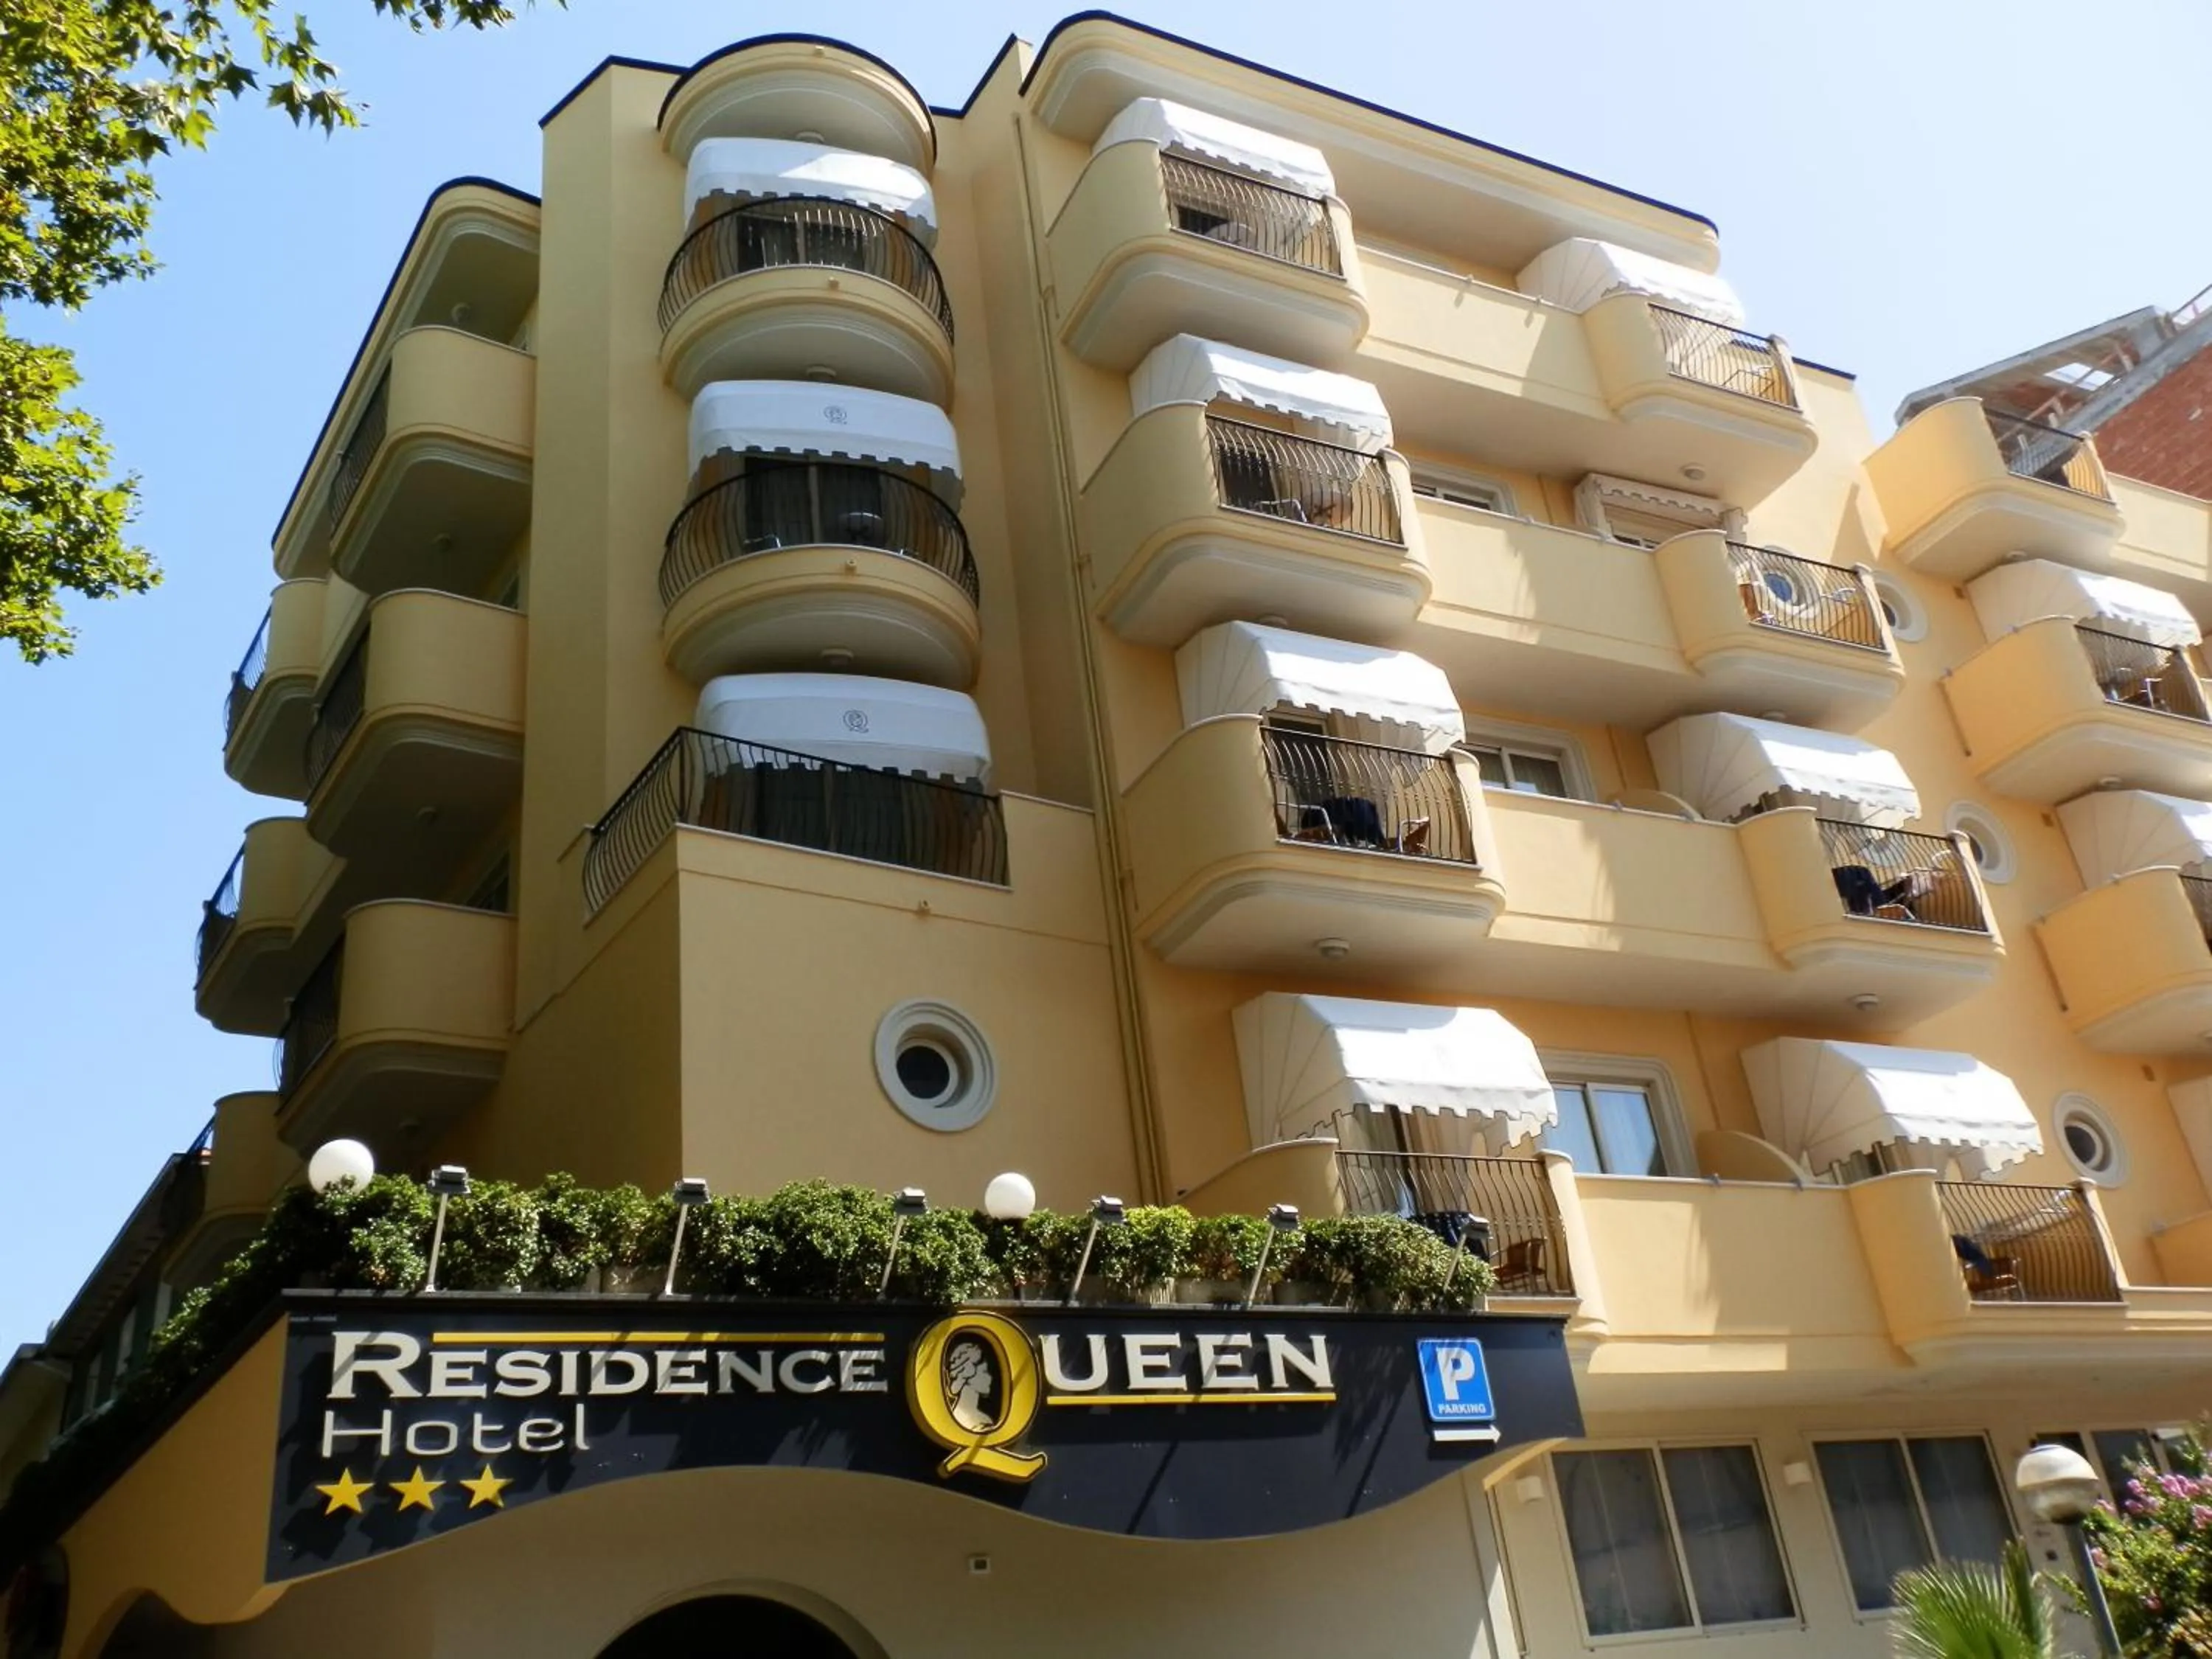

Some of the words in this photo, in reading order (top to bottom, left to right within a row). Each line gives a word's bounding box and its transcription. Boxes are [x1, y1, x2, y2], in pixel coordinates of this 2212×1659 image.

[327, 1331, 888, 1398] RESIDENCE
[906, 1311, 1336, 1484] QUEEN
[1436, 1347, 1475, 1400] P
[321, 1403, 590, 1458] Hotel
[1438, 1403, 1486, 1414] PARKING
